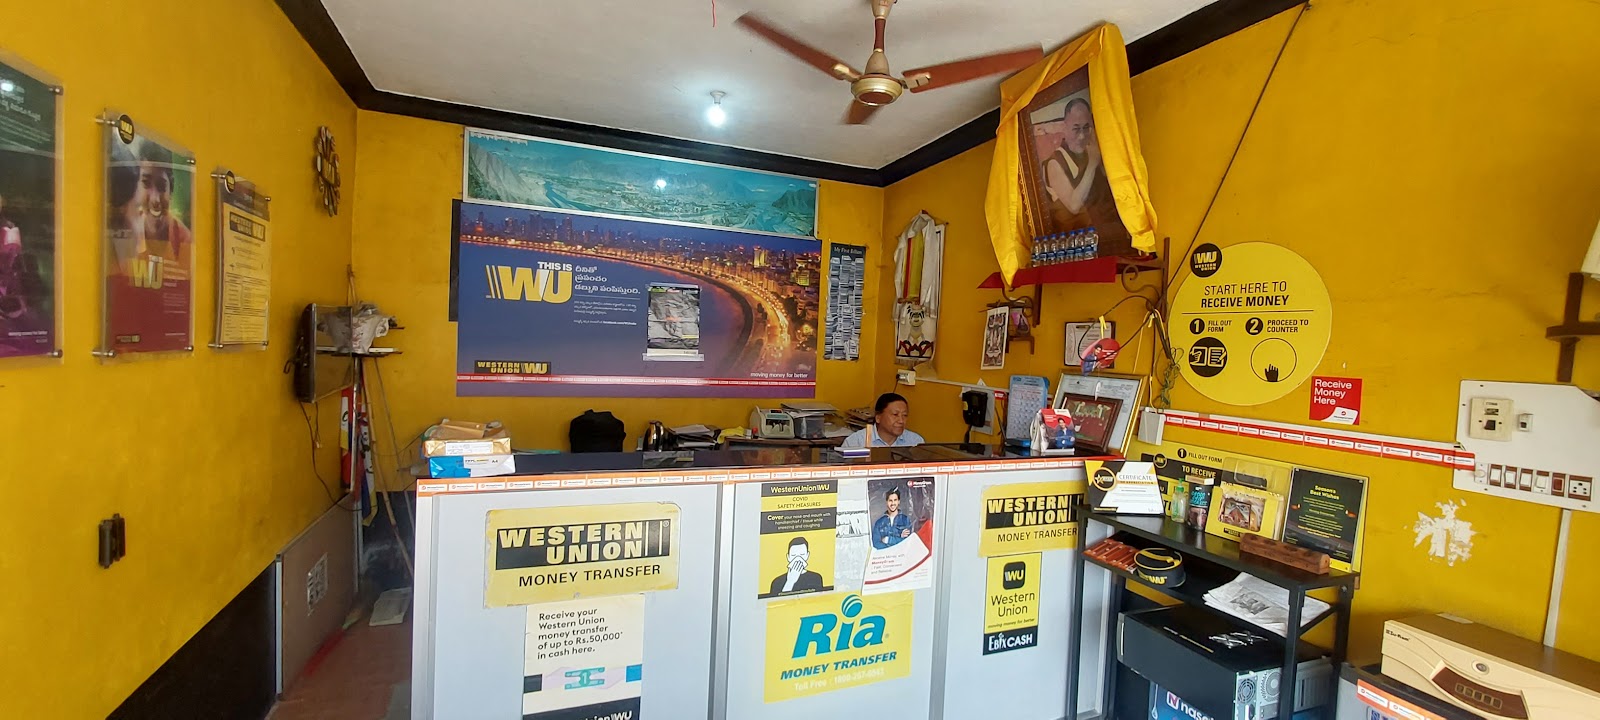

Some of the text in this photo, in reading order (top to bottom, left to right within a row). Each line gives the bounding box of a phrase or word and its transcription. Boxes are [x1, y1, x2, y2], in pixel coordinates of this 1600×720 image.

[1196, 251, 1217, 263] WU
[537, 261, 572, 271] THIS IS
[496, 266, 573, 304] WU
[1204, 281, 1287, 296] START HERE TO
[1200, 295, 1290, 308] RECEIVE MONEY
[1249, 318, 1259, 334] 2
[523, 362, 548, 374] WU
[1315, 379, 1352, 389] Receive
[1313, 396, 1336, 405] Here
[1314, 388, 1346, 399] Money
[1182, 465, 1216, 478] TO RECEIVE
[988, 495, 1069, 514] WESTERN
[1013, 509, 1068, 526] UNION
[498, 521, 643, 548] WESTERN
[997, 528, 1078, 543] MONEY TRANSFER
[546, 540, 643, 565] UNION
[518, 564, 661, 587] MONEY TRANSFER
[1007, 569, 1024, 582] WU
[990, 591, 1035, 606] Western
[539, 608, 598, 620] Receive your
[998, 604, 1028, 618] Union
[539, 617, 605, 630] Western Union
[791, 594, 886, 658] Ria
[538, 626, 608, 640] money transfer
[537, 641, 548, 650] of
[549, 641, 562, 650] up
[537, 646, 596, 660] in cash here.
[780, 651, 897, 680] MONEY TRANSFER
[794, 681, 809, 691] Toll
[810, 679, 827, 688] Free
[1181, 702, 1214, 720] nas
